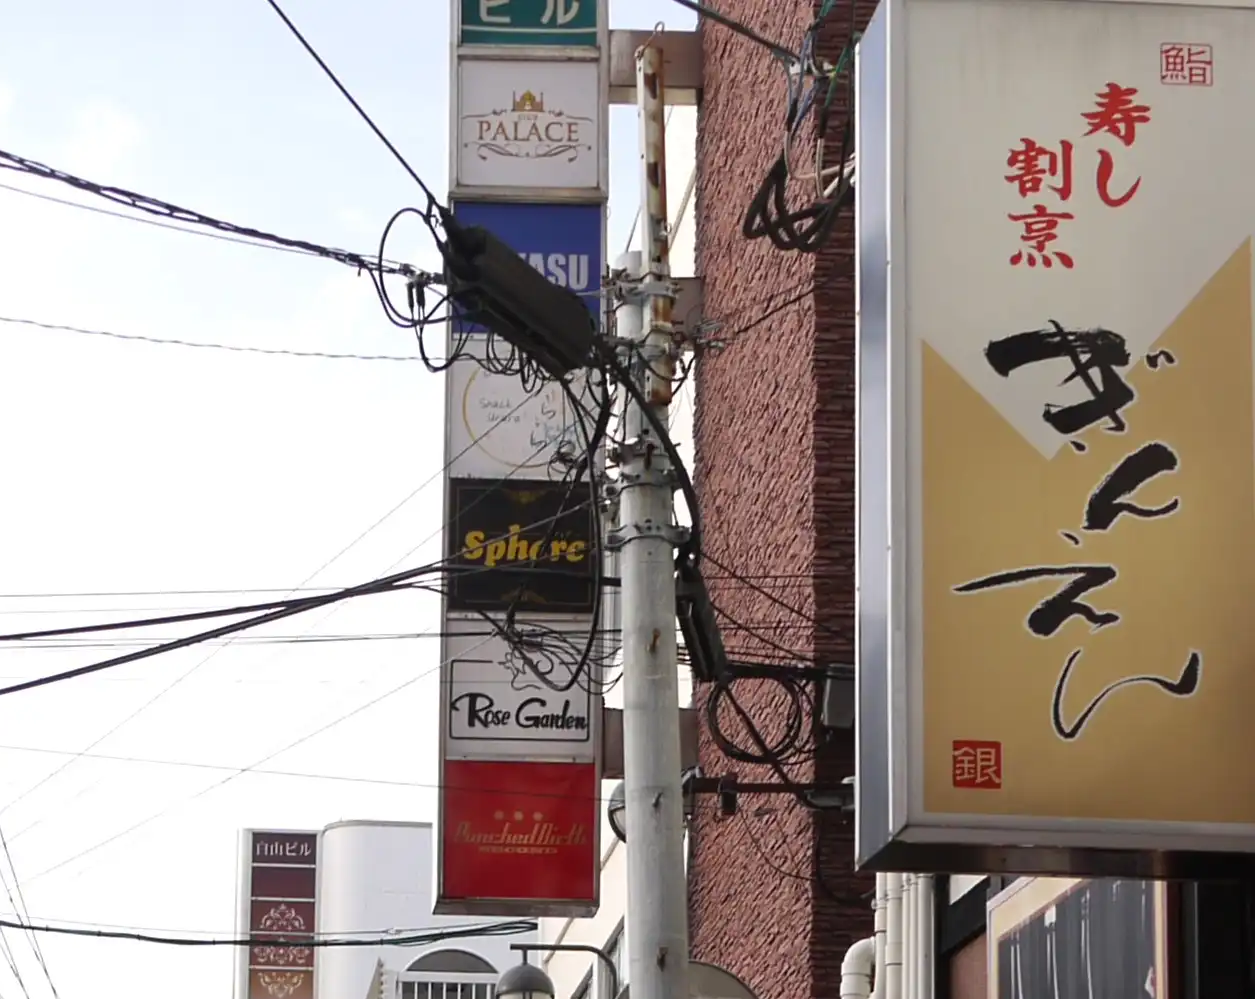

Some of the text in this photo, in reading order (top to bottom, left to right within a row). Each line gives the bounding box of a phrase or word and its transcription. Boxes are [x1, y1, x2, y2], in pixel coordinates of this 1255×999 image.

[1160, 42, 1214, 87] 鮨
[477, 120, 580, 142] PALACE
[1080, 82, 1151, 208] 寿し
[1004, 138, 1075, 269] 割烹
[450, 692, 588, 730] Rose Garden
